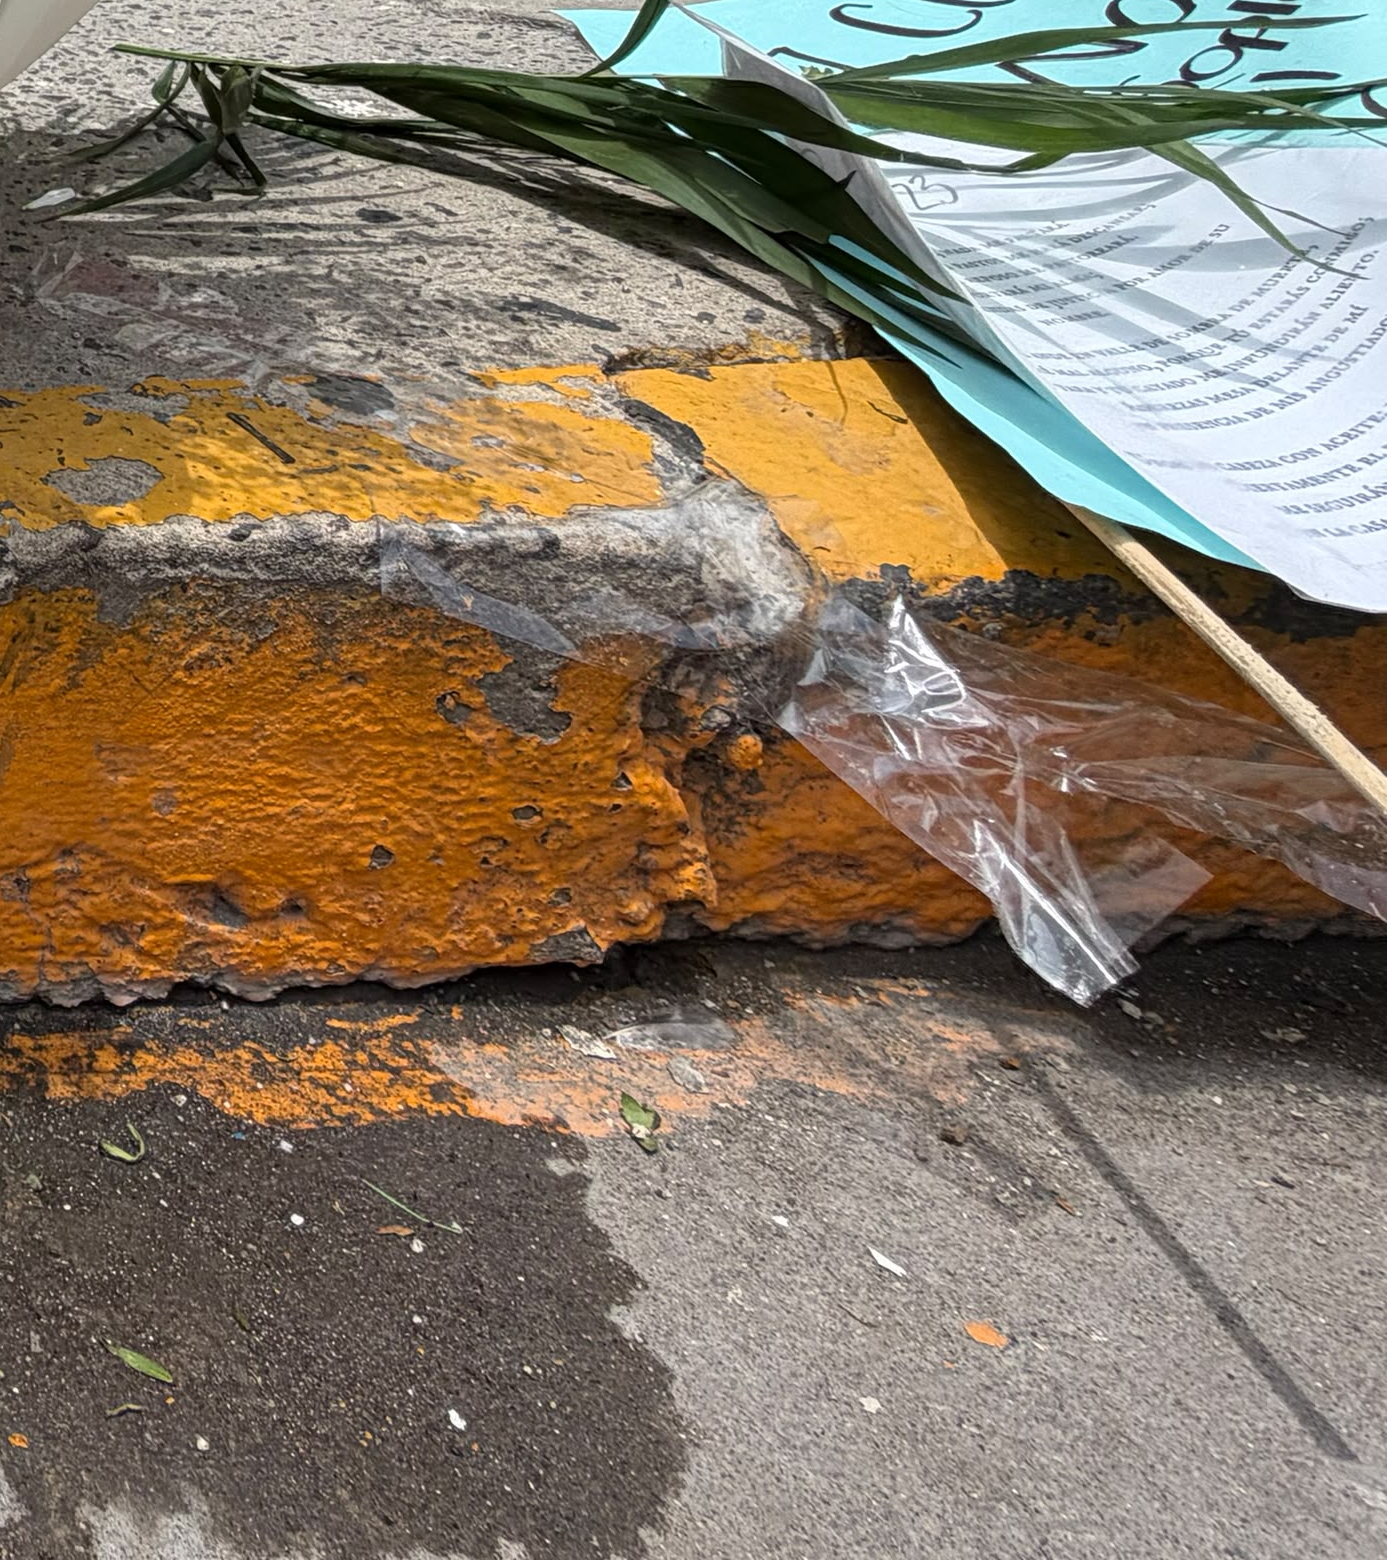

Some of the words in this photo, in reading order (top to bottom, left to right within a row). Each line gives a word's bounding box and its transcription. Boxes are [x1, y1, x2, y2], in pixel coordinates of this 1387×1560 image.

[1147, 254, 1193, 278] AMOR
[1189, 239, 1215, 253] DE
[1208, 223, 1231, 239] SU
[1154, 342, 1228, 368] PORQUE
[1221, 327, 1252, 343] TÚ
[1248, 284, 1312, 330] ESTARÁS
[1165, 312, 1235, 342] SOMBRA
[1228, 297, 1256, 312] DE
[1221, 311, 1323, 372] INFUNDIRÁN
[1203, 386, 1257, 404] MESA
[1248, 344, 1330, 388] DELANTE
[1322, 326, 1349, 343] DE
[1341, 303, 1370, 324] MÍ
[1242, 406, 1276, 420] DE
[1268, 391, 1308, 410] MIS
[1305, 313, 1387, 395] ANGUSTIADO
[1278, 447, 1323, 465] CON
